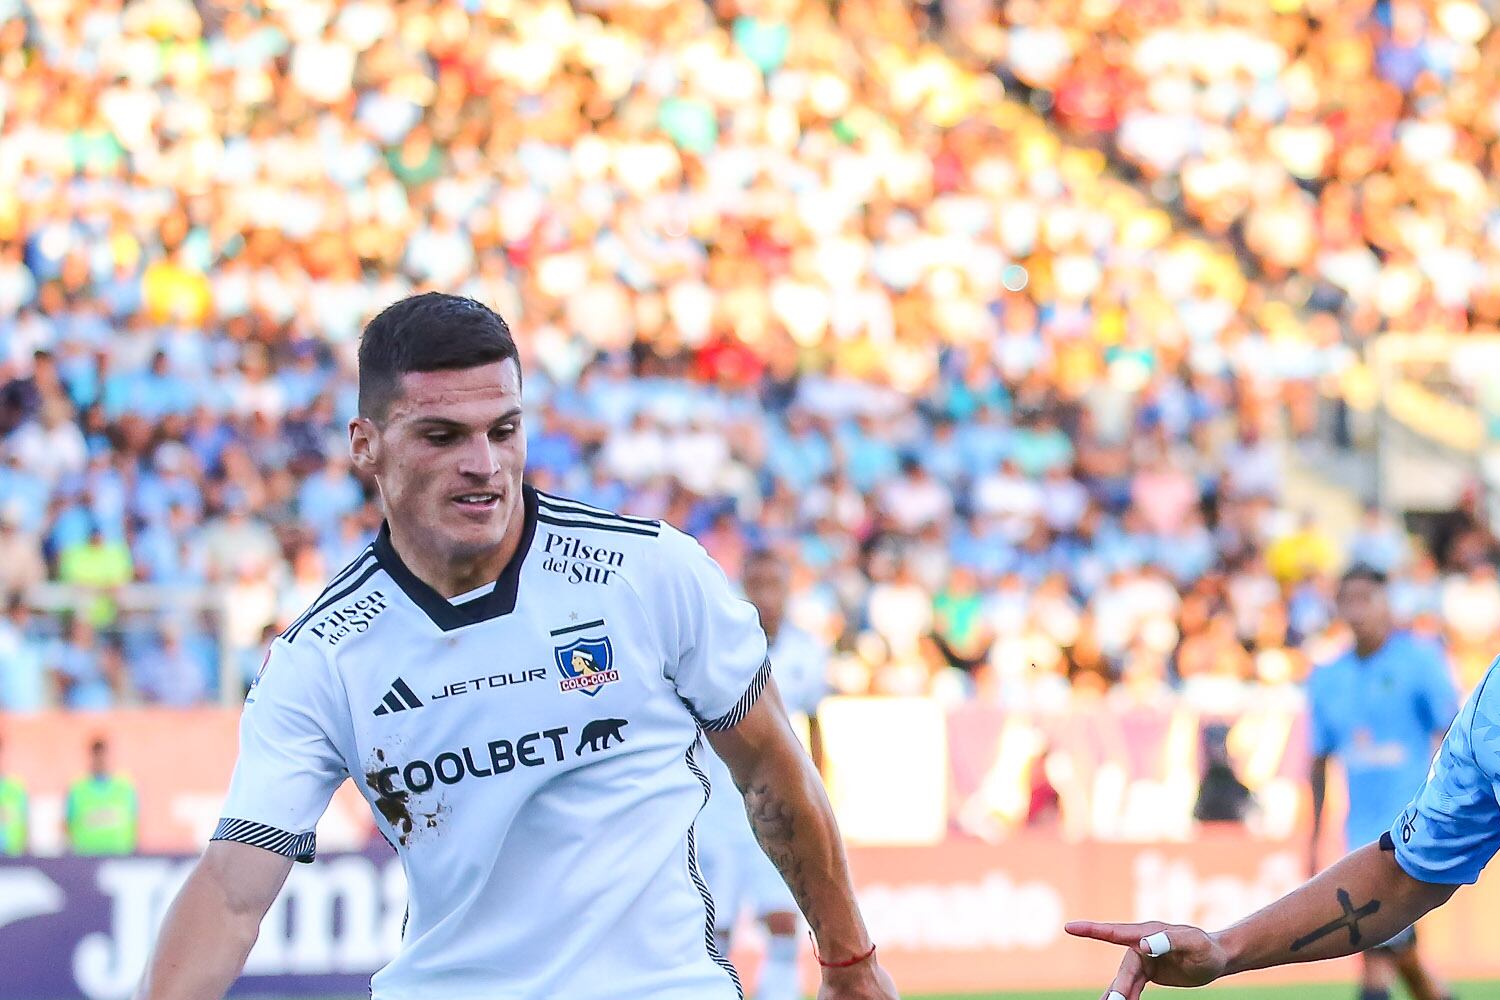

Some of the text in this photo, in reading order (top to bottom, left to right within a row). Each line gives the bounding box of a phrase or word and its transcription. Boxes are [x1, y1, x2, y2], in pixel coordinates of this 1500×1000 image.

[545, 532, 624, 567] Pilsen
[543, 557, 616, 586] del Sur
[310, 590, 385, 639] Pilsen
[328, 599, 388, 646] del Sur
[432, 668, 547, 700] JETOUR
[561, 671, 617, 690] COLO-COLO
[378, 726, 569, 799] COOLBET
